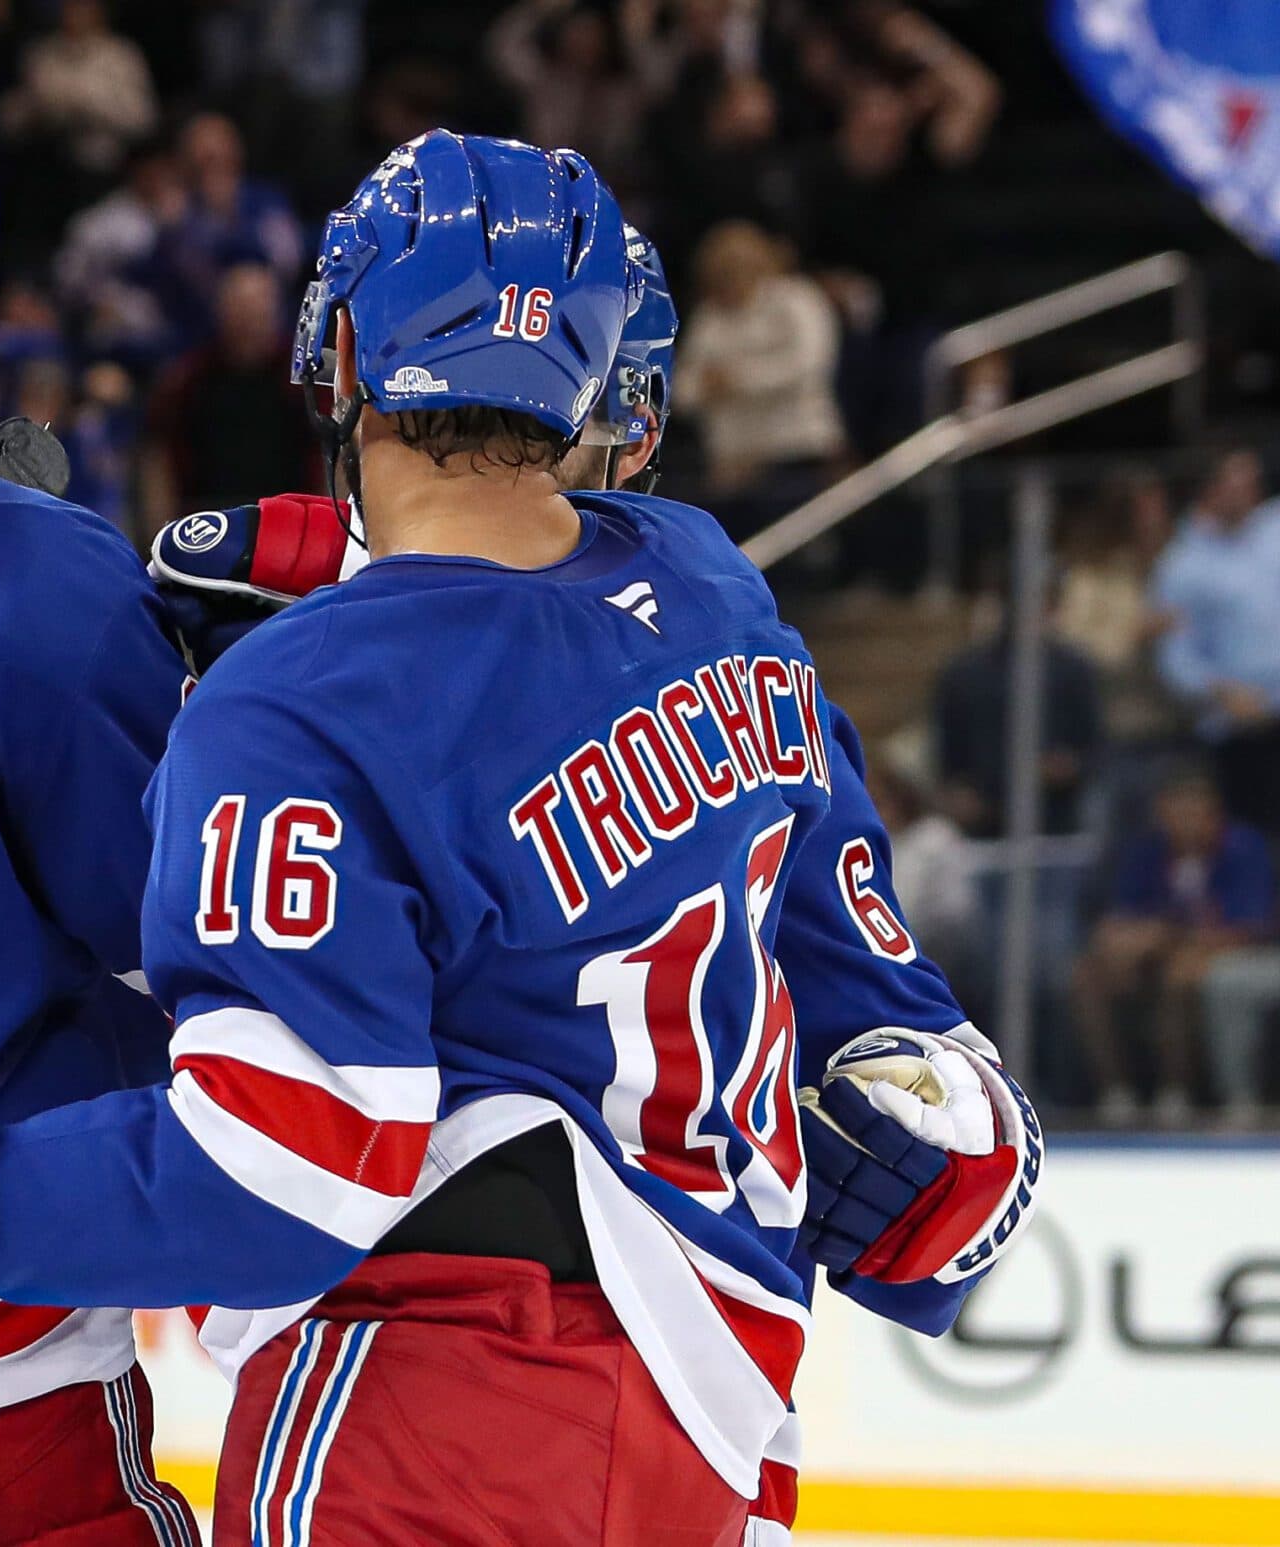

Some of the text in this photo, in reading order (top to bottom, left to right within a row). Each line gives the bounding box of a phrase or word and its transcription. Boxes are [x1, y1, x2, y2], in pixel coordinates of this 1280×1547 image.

[492, 283, 553, 342] 16
[508, 655, 832, 925] TROCHCK
[194, 794, 343, 950] 16
[835, 836, 917, 965] 6
[576, 812, 808, 1228] 16
